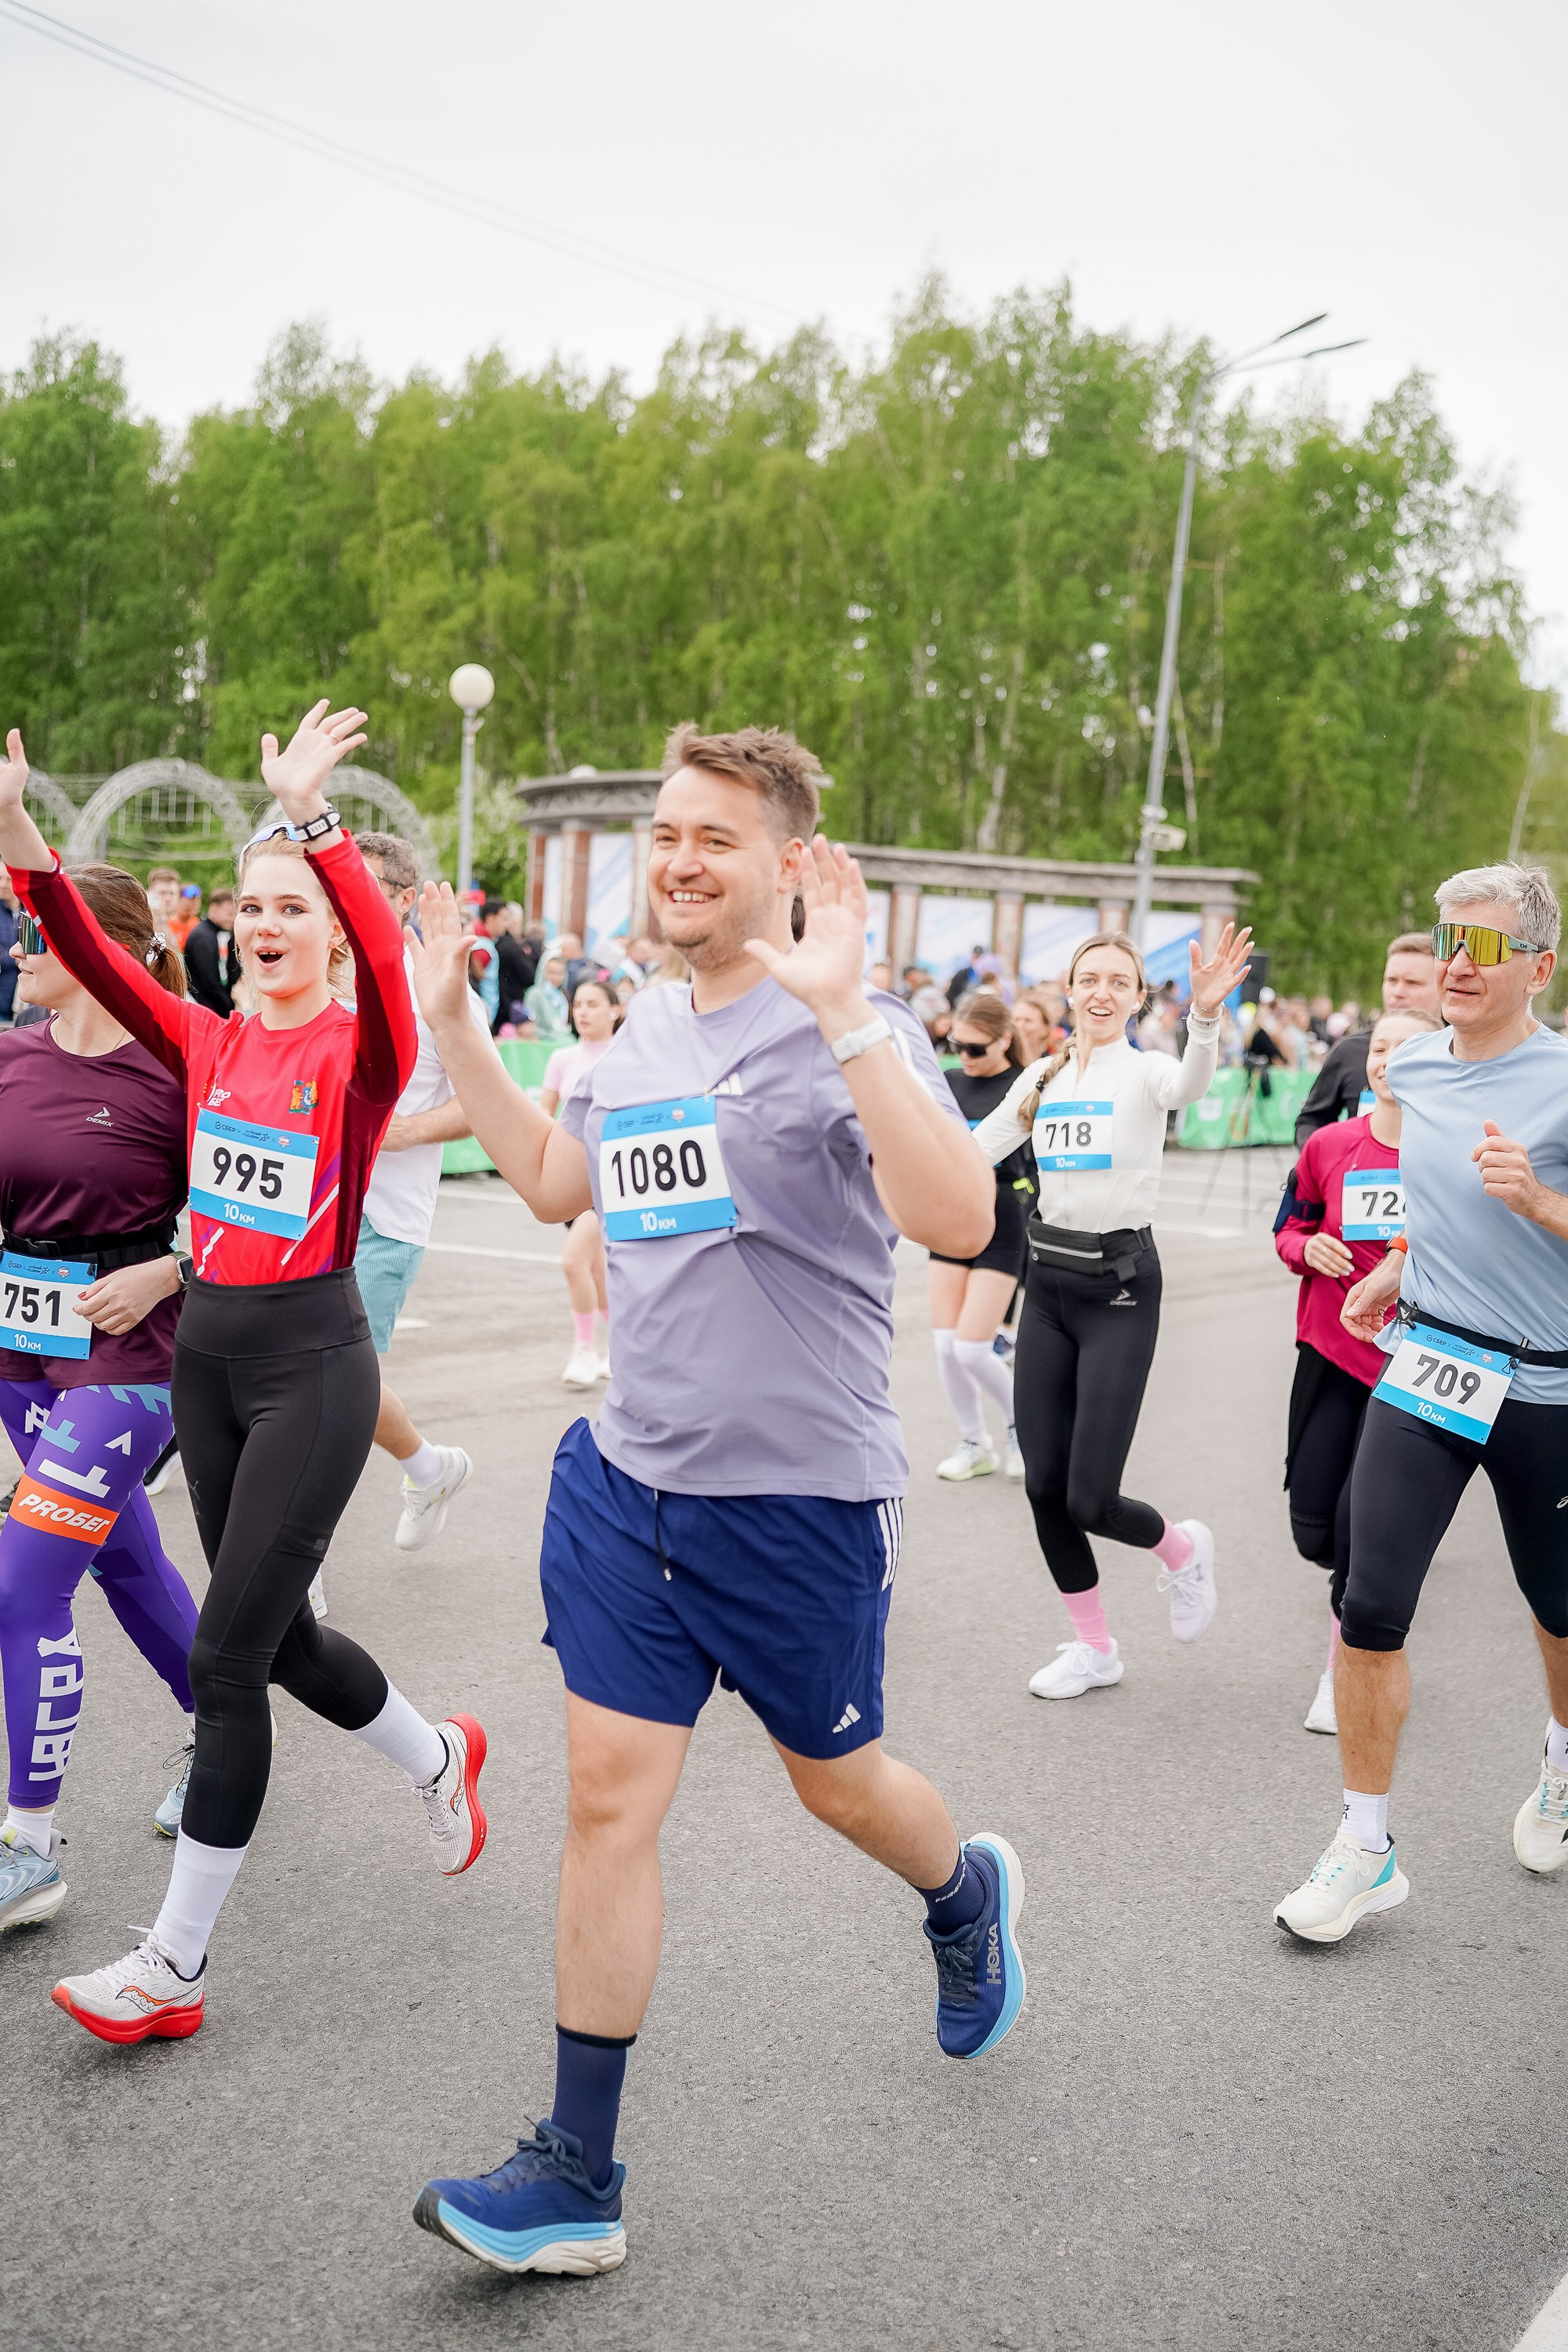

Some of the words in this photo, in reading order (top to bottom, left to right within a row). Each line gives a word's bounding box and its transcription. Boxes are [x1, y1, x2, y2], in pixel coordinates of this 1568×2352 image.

[85, 1116, 114, 1127] DEMIX
[1046, 1122, 1091, 1149] 718
[213, 1146, 285, 1200] 995
[612, 1139, 706, 1197] 1080
[1362, 1191, 1406, 1217] 72
[4, 1282, 61, 1327] 751
[1411, 1353, 1481, 1405] 709
[986, 1922, 1002, 1985] HOKA
